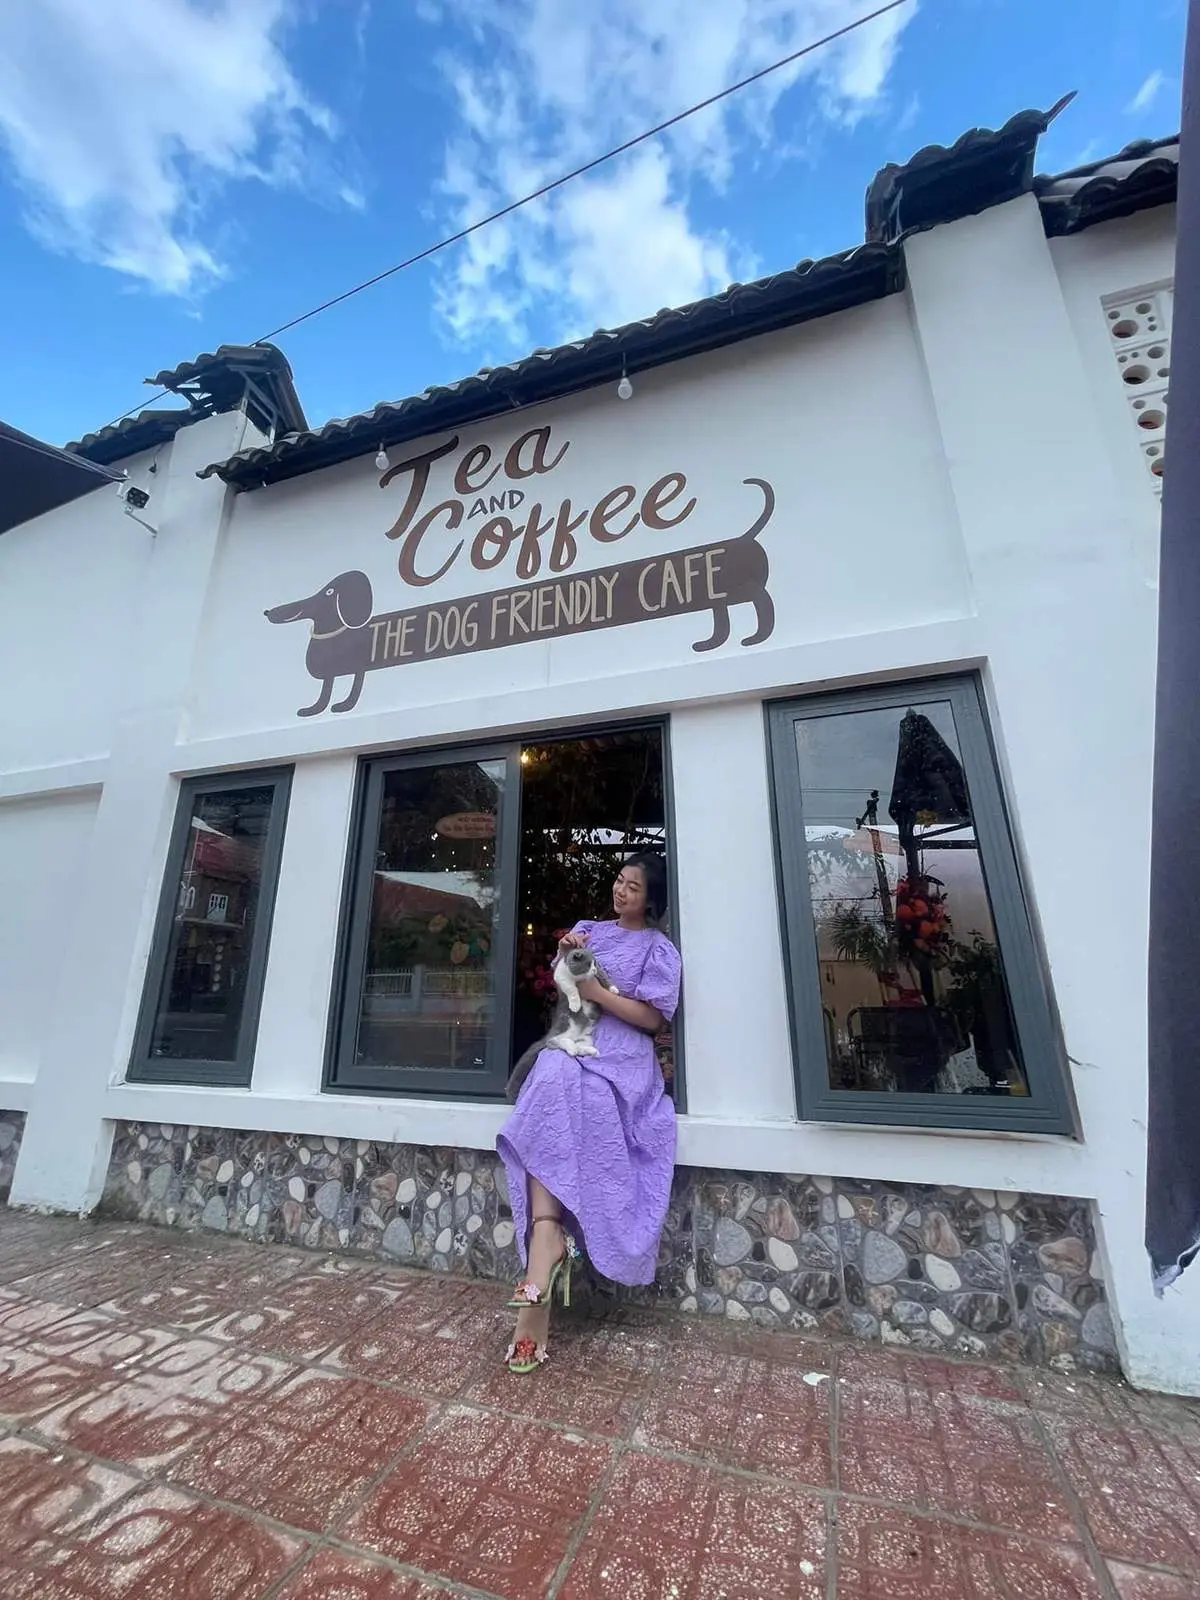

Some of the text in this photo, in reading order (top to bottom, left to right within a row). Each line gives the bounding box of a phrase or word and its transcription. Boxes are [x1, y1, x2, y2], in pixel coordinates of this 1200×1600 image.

[379, 426, 570, 540] Tea
[399, 472, 697, 587] Coffee
[467, 489, 525, 520] AND
[369, 548, 727, 662] THE DOG FRIENDLY CAFE
